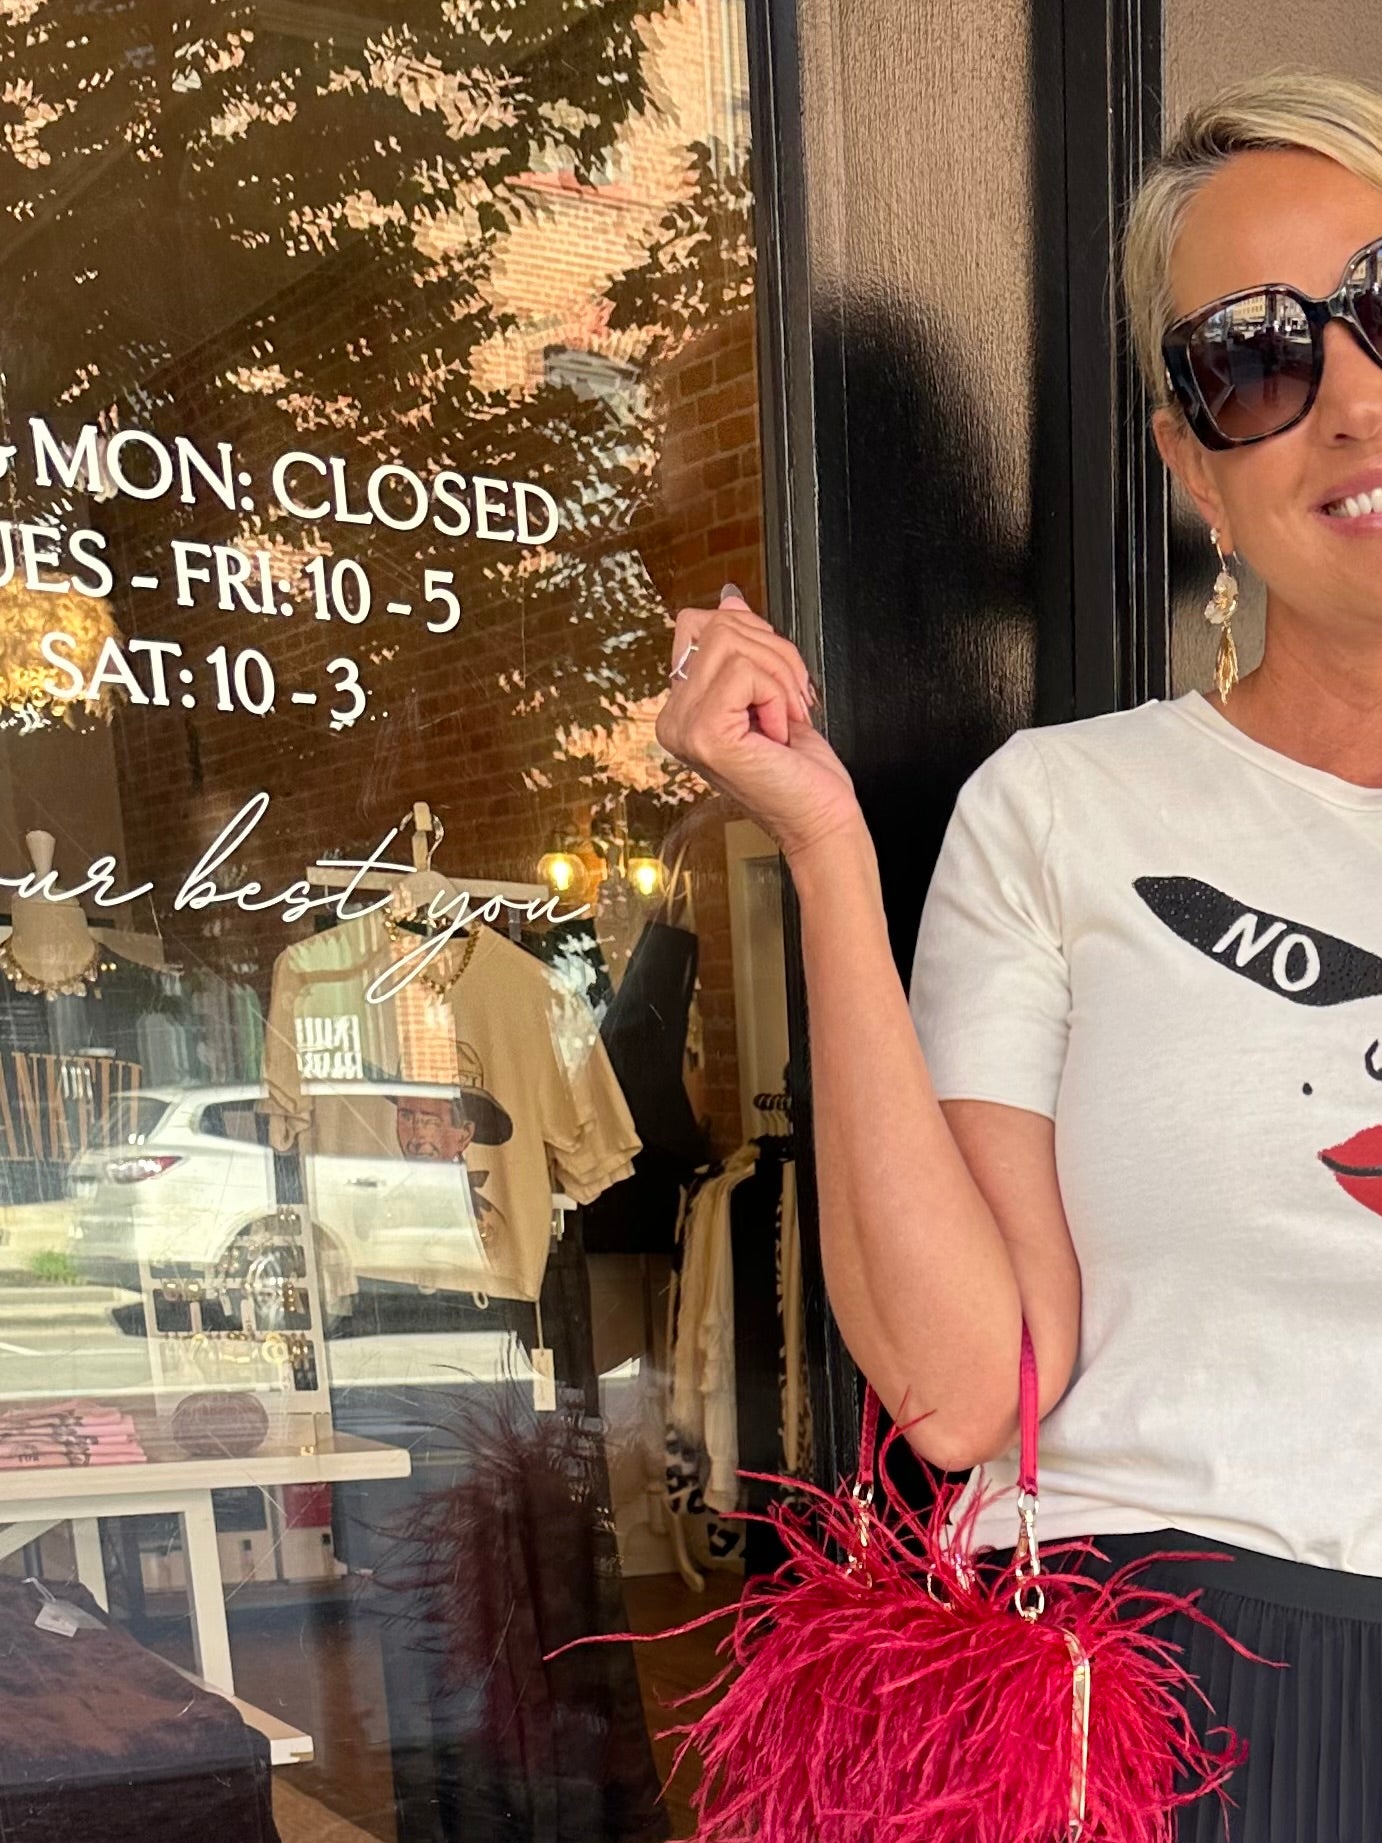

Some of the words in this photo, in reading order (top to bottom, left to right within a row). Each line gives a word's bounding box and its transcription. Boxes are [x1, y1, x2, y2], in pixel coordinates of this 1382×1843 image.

[28, 417, 255, 511] MON:
[272, 452, 560, 545] CLOSED
[171, 540, 293, 616] FRI:
[305, 556, 371, 624] 10
[424, 569, 461, 633] 5
[41, 632, 195, 706] SAT:
[206, 646, 275, 715] 10
[326, 658, 366, 722] 3
[0, 855, 154, 907] ur
[174, 791, 418, 923] best
[366, 888, 592, 1004] you
[1212, 913, 1321, 992] NO
